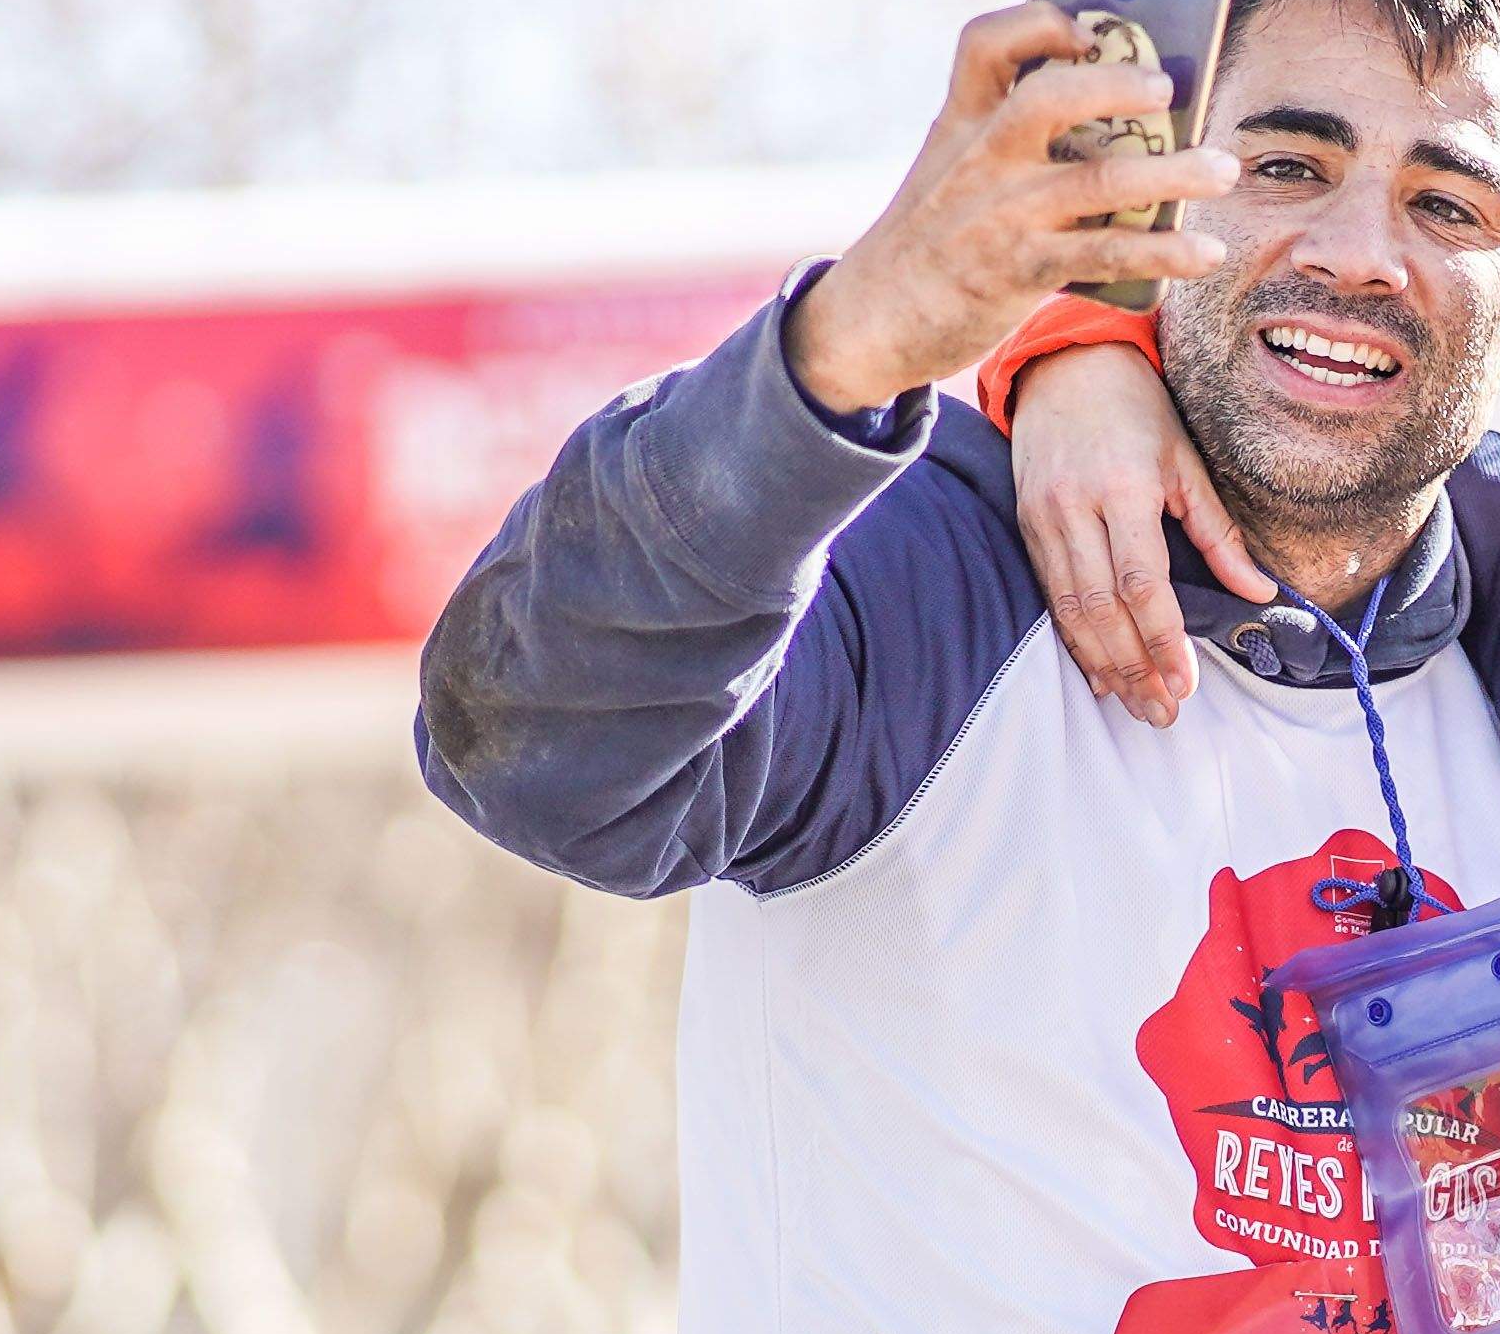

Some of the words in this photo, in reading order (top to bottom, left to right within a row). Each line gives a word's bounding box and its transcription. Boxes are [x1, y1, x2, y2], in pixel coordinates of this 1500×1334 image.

[1334, 924, 1349, 934] de
[1251, 1094, 1356, 1129] CARRERA
[1337, 1136, 1353, 1153] de
[1214, 1129, 1344, 1219] REYES
[1215, 1208, 1359, 1260] COMUNIDAD
